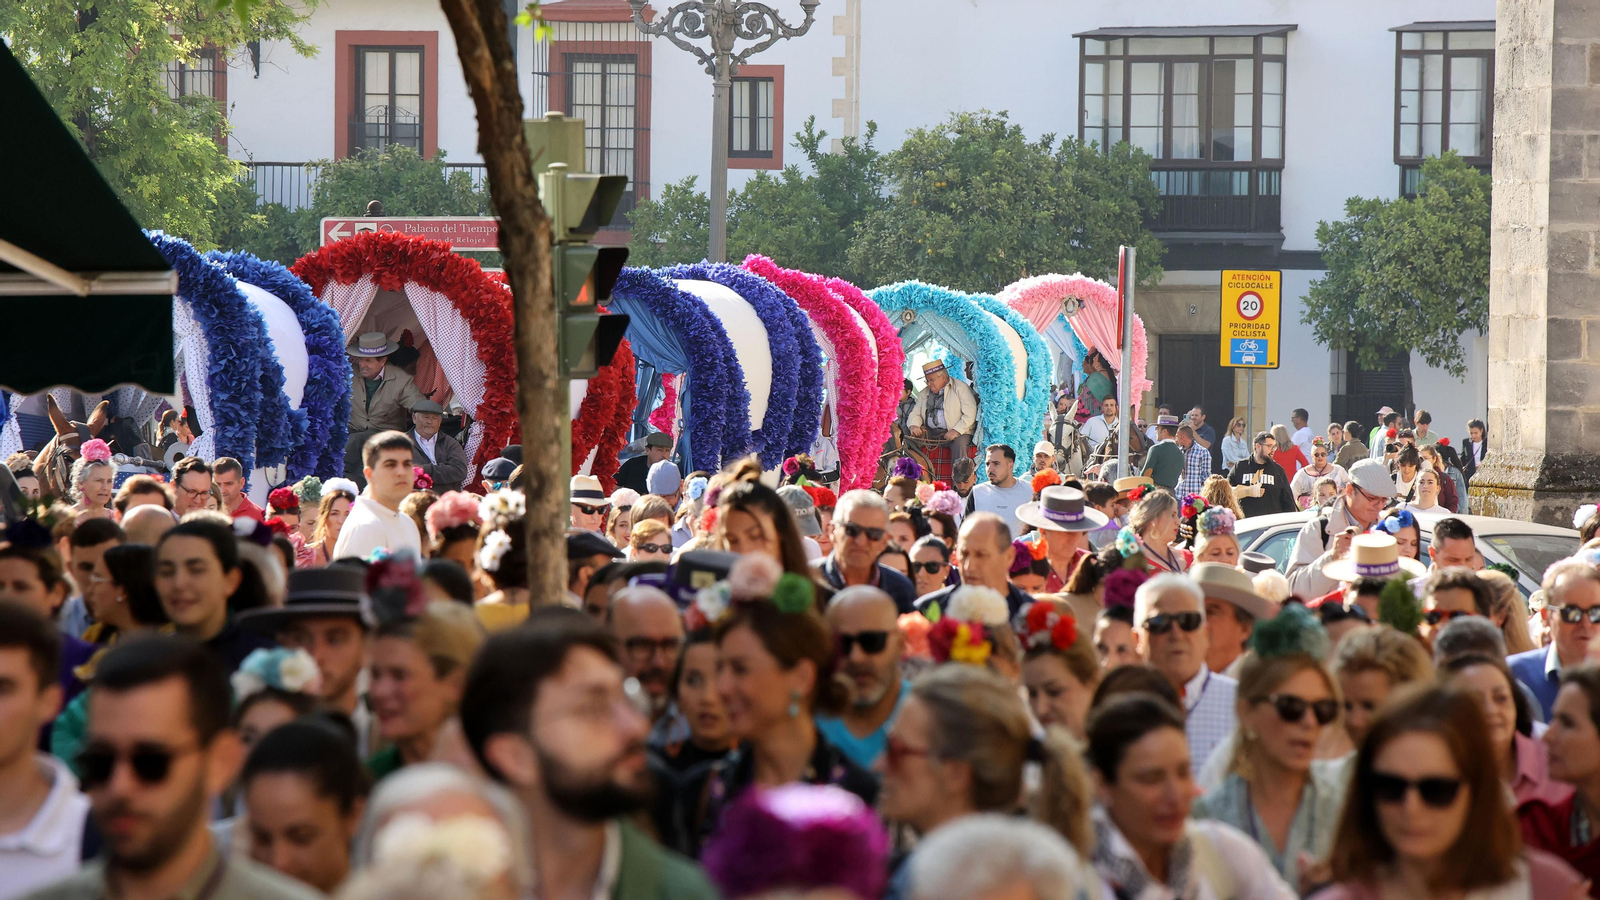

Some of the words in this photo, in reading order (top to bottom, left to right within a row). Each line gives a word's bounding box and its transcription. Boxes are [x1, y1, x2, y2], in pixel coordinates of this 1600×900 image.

[404, 223, 440, 233] Palacio
[441, 223, 457, 233] del
[459, 223, 498, 236] Tiempo
[456, 236, 486, 244] Relojes
[1231, 273, 1271, 281] ATENCIÓN
[1242, 300, 1258, 311] 20
[1229, 322, 1271, 330] PRIORIDAD
